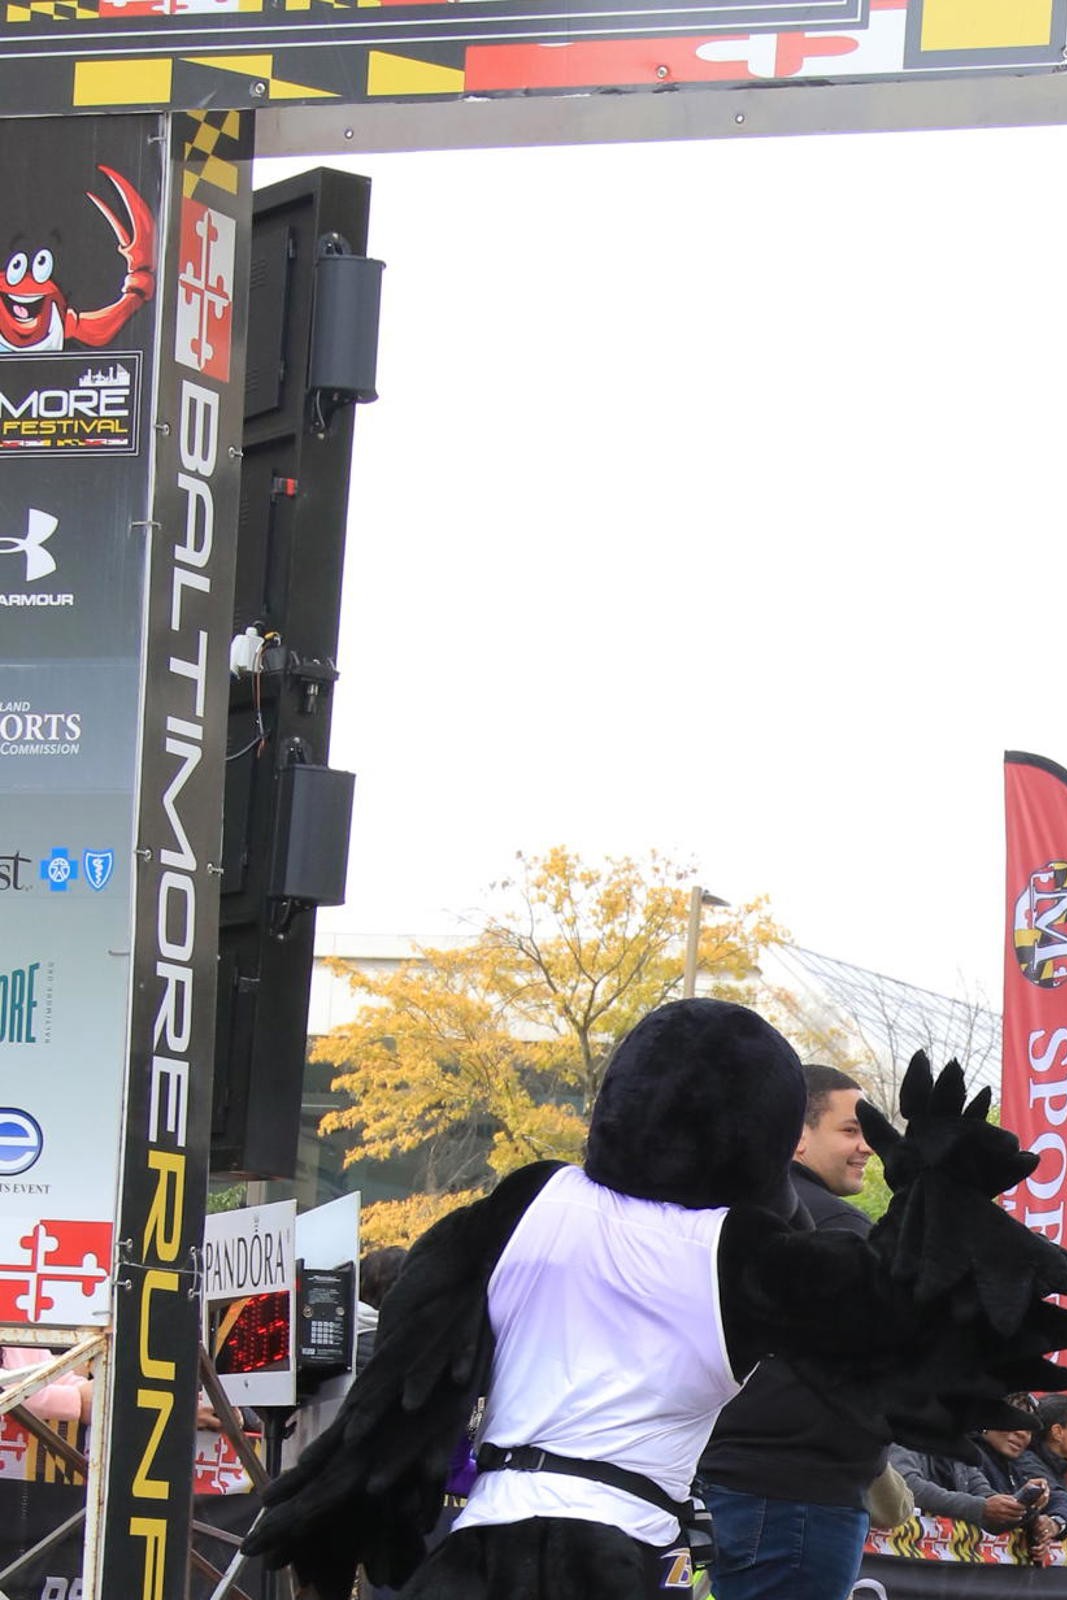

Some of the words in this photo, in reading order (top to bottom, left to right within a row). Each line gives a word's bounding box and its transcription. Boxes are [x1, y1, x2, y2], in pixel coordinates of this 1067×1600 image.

[0, 388, 130, 418] MORE
[3, 419, 128, 434] FESTIVAL
[1, 742, 80, 755] COMMISSION
[148, 380, 220, 1148] BALTIMORE
[13, 1183, 48, 1194] EVENT
[205, 1231, 286, 1293] PANDORA
